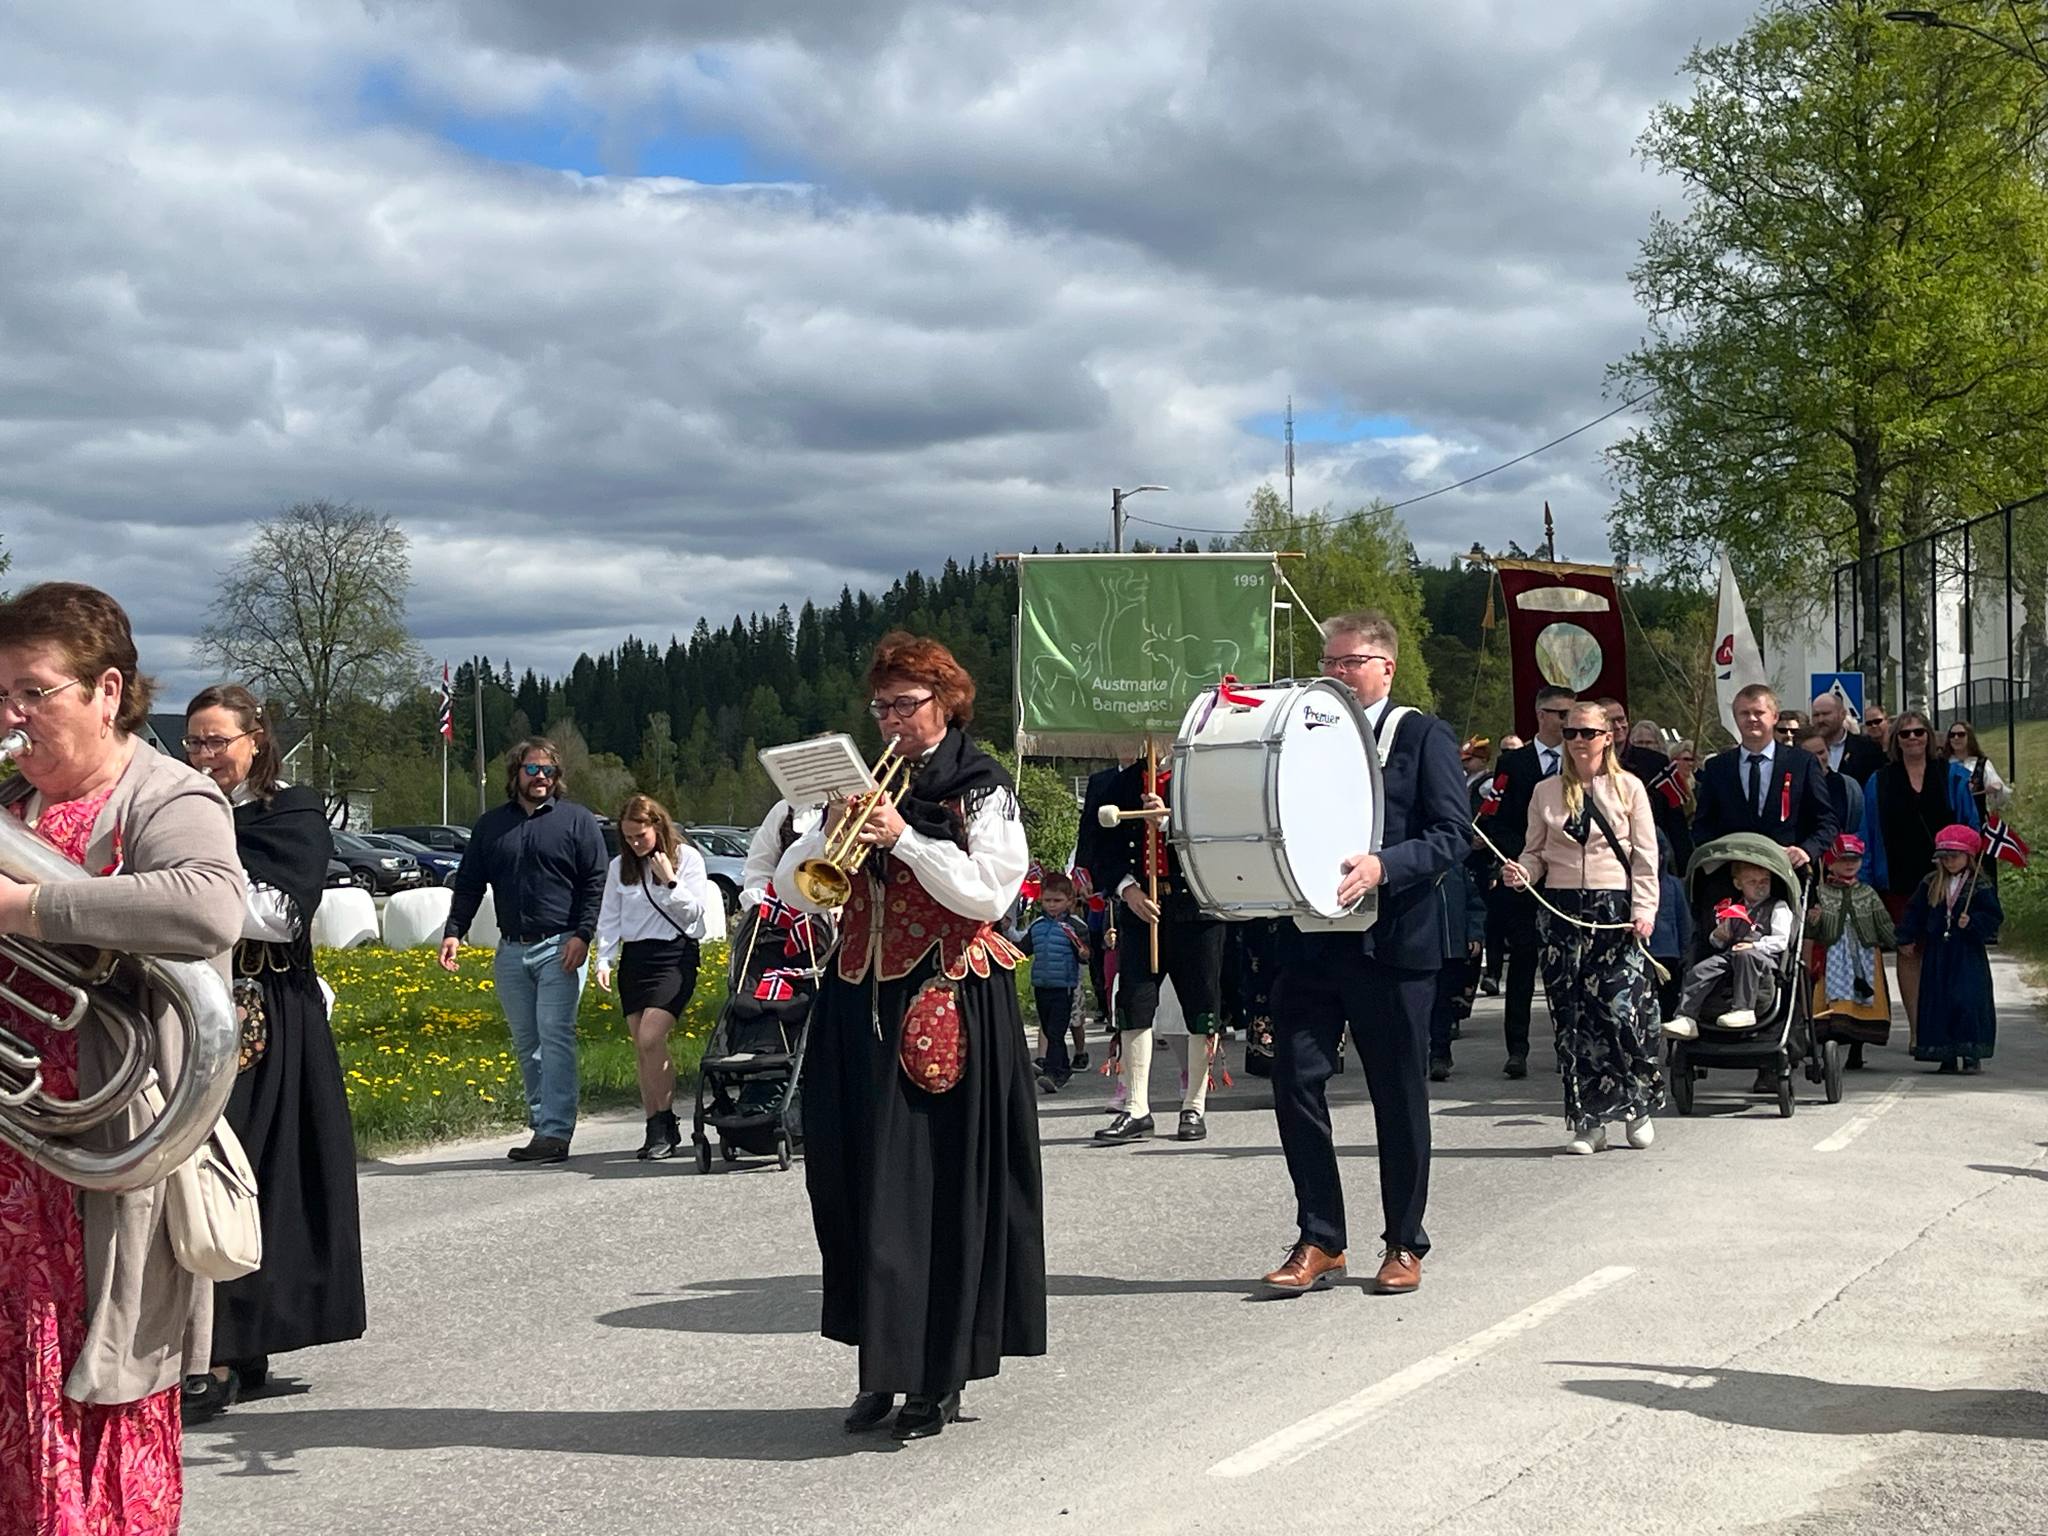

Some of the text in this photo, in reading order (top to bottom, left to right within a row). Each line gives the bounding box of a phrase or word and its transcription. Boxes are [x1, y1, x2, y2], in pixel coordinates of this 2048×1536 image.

[1232, 574, 1265, 587] 1991
[1092, 676, 1168, 692] Austmarka
[1303, 705, 1340, 725] Premier
